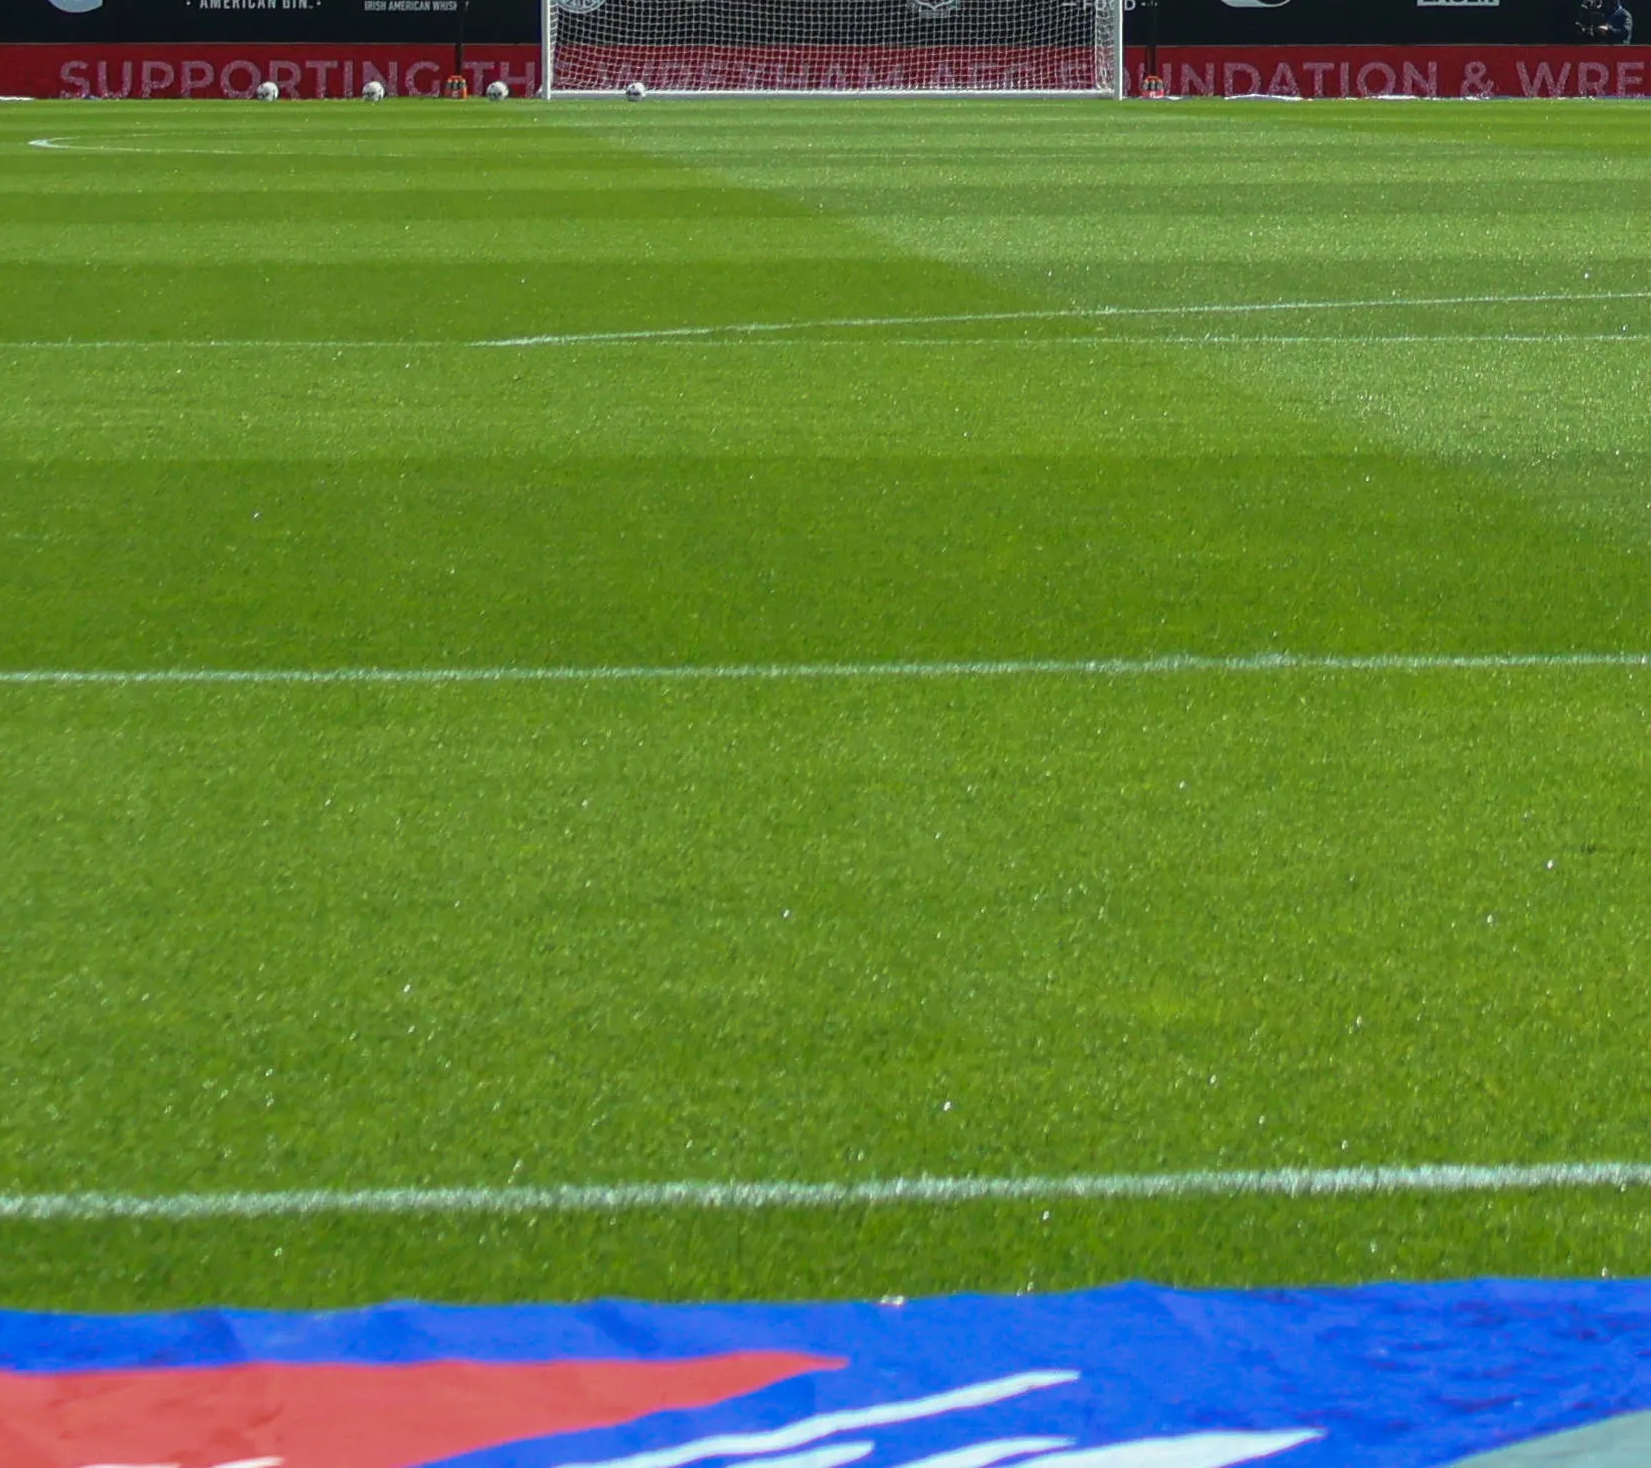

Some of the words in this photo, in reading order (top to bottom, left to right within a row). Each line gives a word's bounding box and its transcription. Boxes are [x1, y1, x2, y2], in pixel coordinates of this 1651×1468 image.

[364, 0, 387, 11] IRISH
[388, 0, 431, 11] AMERICAN
[60, 60, 442, 100] SUPPORTING
[1459, 61, 1496, 98] &
